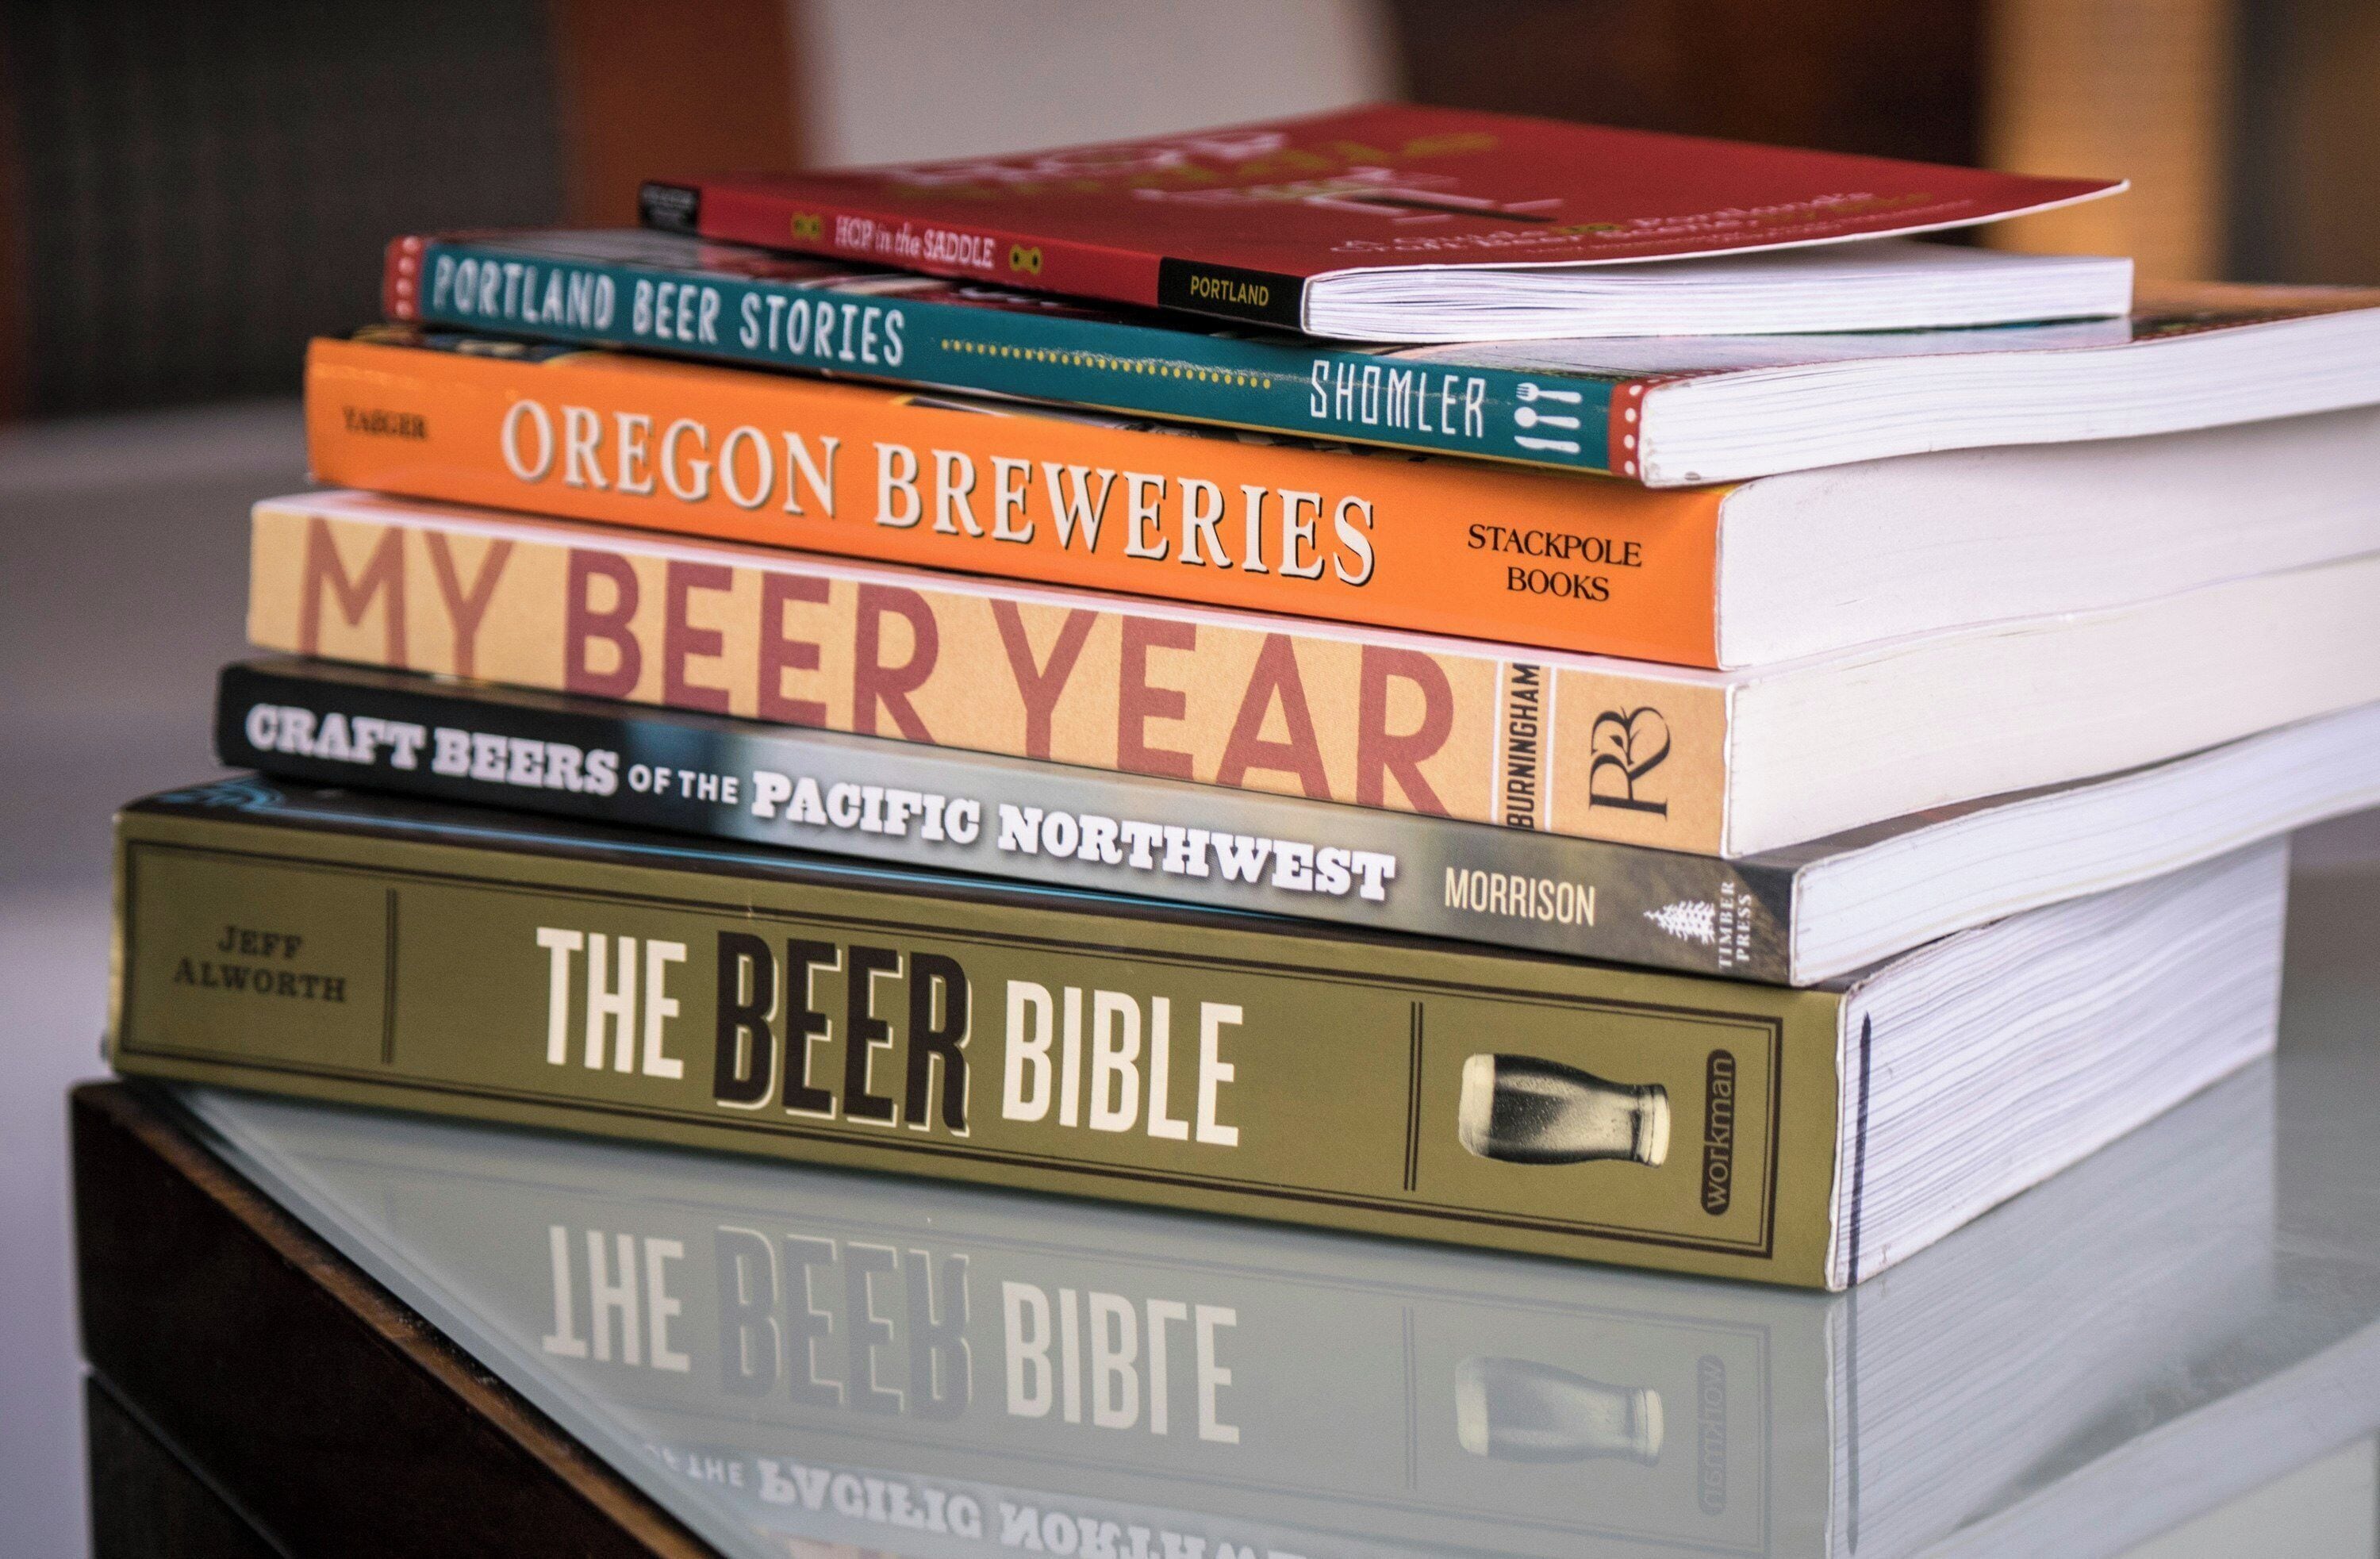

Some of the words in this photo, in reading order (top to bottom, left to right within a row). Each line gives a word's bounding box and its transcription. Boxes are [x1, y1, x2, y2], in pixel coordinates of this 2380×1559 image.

[835, 215, 873, 250] HOP
[875, 223, 893, 253] in
[894, 221, 921, 259] the
[923, 228, 996, 270] SADDLE
[432, 253, 616, 329] PORTLAND
[632, 278, 720, 344] BEER
[739, 290, 906, 367] STORIES
[1191, 275, 1269, 306] PORTLAND
[1311, 359, 1485, 439] SHOMLER
[501, 398, 840, 518] OREGON
[873, 441, 1375, 586] BREWERIES
[1468, 524, 1642, 568] STACKPOLE
[1507, 566, 1609, 601] BOOKS
[299, 516, 514, 679] MY
[563, 547, 939, 743] BEER
[988, 598, 1455, 817] YEAR
[1507, 662, 1540, 830] BURNINGHAM
[245, 703, 426, 770] CRAFT
[431, 727, 620, 796] BEERS
[628, 763, 670, 794] OF
[678, 769, 739, 804] THE
[751, 770, 980, 843] PACIFIC
[998, 804, 1396, 901] NORTHWEST
[1444, 867, 1595, 927] MORRISON
[1718, 881, 1734, 969] TIMBER
[1736, 894, 1752, 962] PRESS
[173, 955, 347, 1004] ALWORTH
[217, 924, 303, 960] JEFF
[536, 926, 687, 1080] THE
[713, 929, 971, 1138] BEER
[1002, 979, 1244, 1147] BIBLE
[1705, 1058, 1733, 1208] workman
